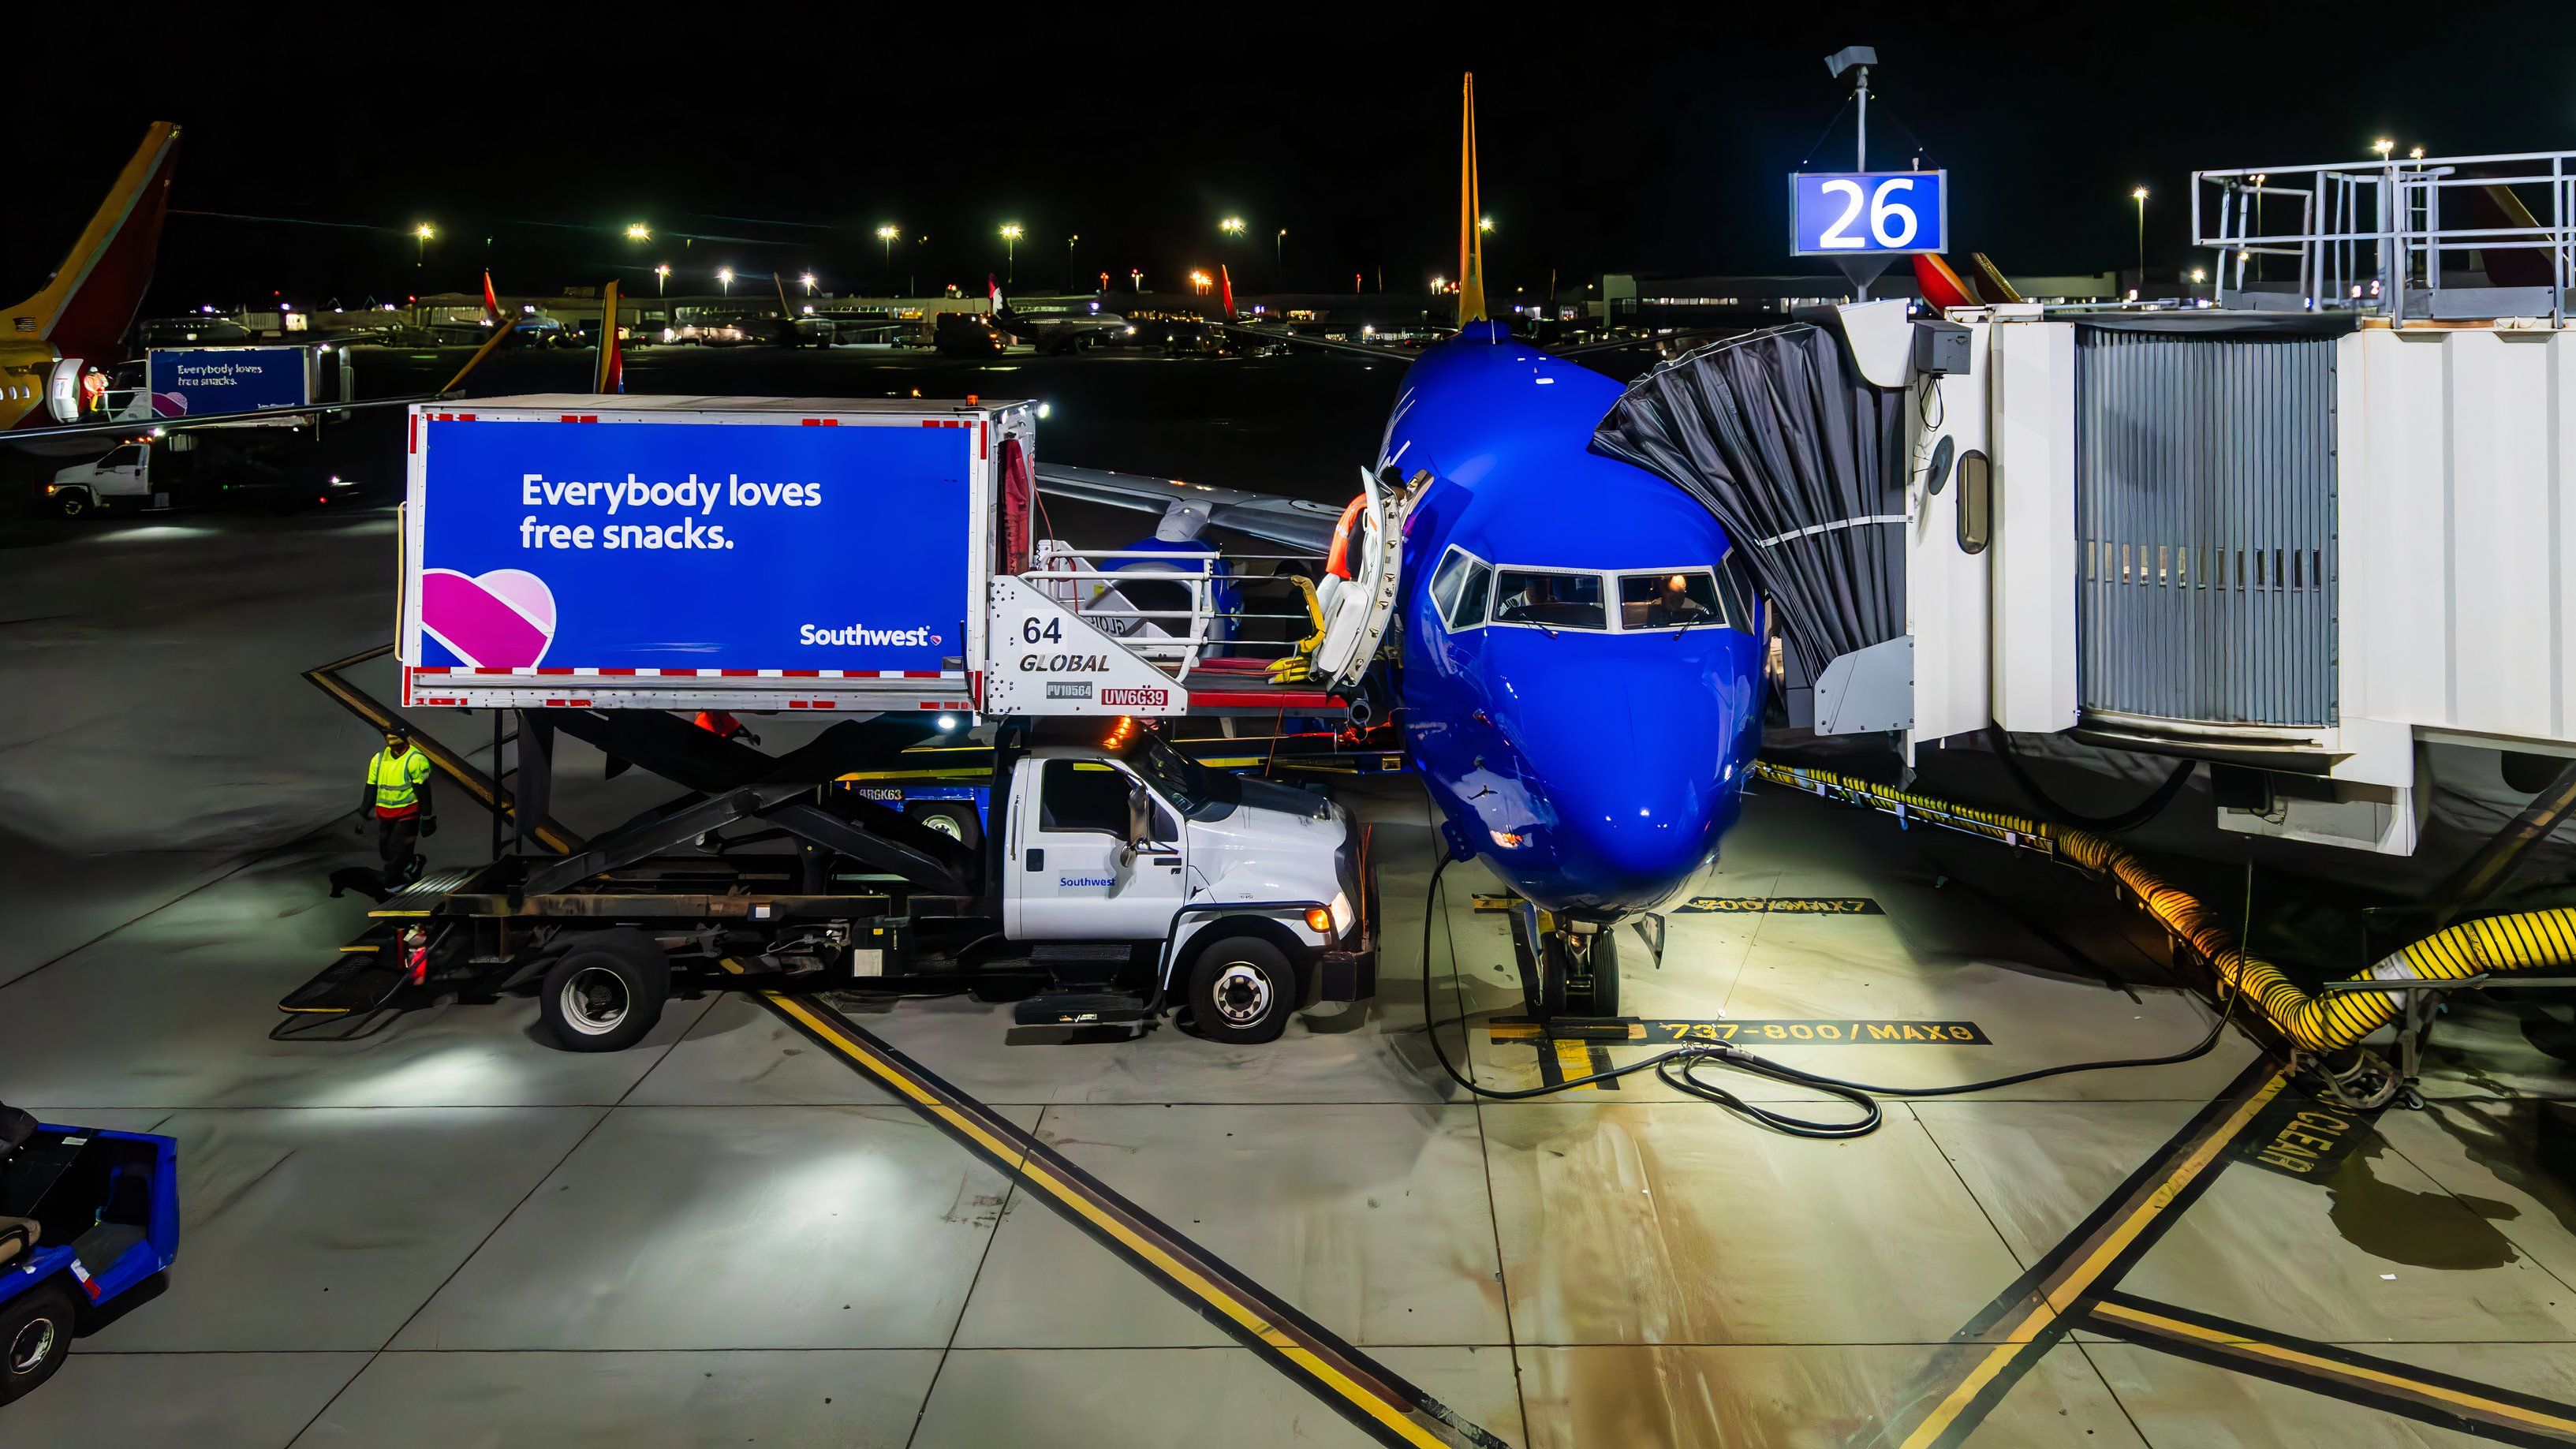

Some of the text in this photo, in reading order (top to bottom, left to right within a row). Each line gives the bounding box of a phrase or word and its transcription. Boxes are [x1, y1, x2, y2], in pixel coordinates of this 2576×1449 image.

[1820, 178, 1917, 248] 26
[177, 364, 233, 375] Everybody
[521, 473, 822, 514] Everybody loves
[520, 516, 734, 550] free snacks.
[800, 623, 929, 647] Southwest
[1023, 617, 1062, 644] 64
[1020, 654, 1110, 672] GLOBAL
[1047, 684, 1092, 697] PV10564
[1104, 689, 1165, 705] UW6G39
[1060, 877, 1115, 887] Southwest
[2257, 1111, 2350, 1173] CLEAR
